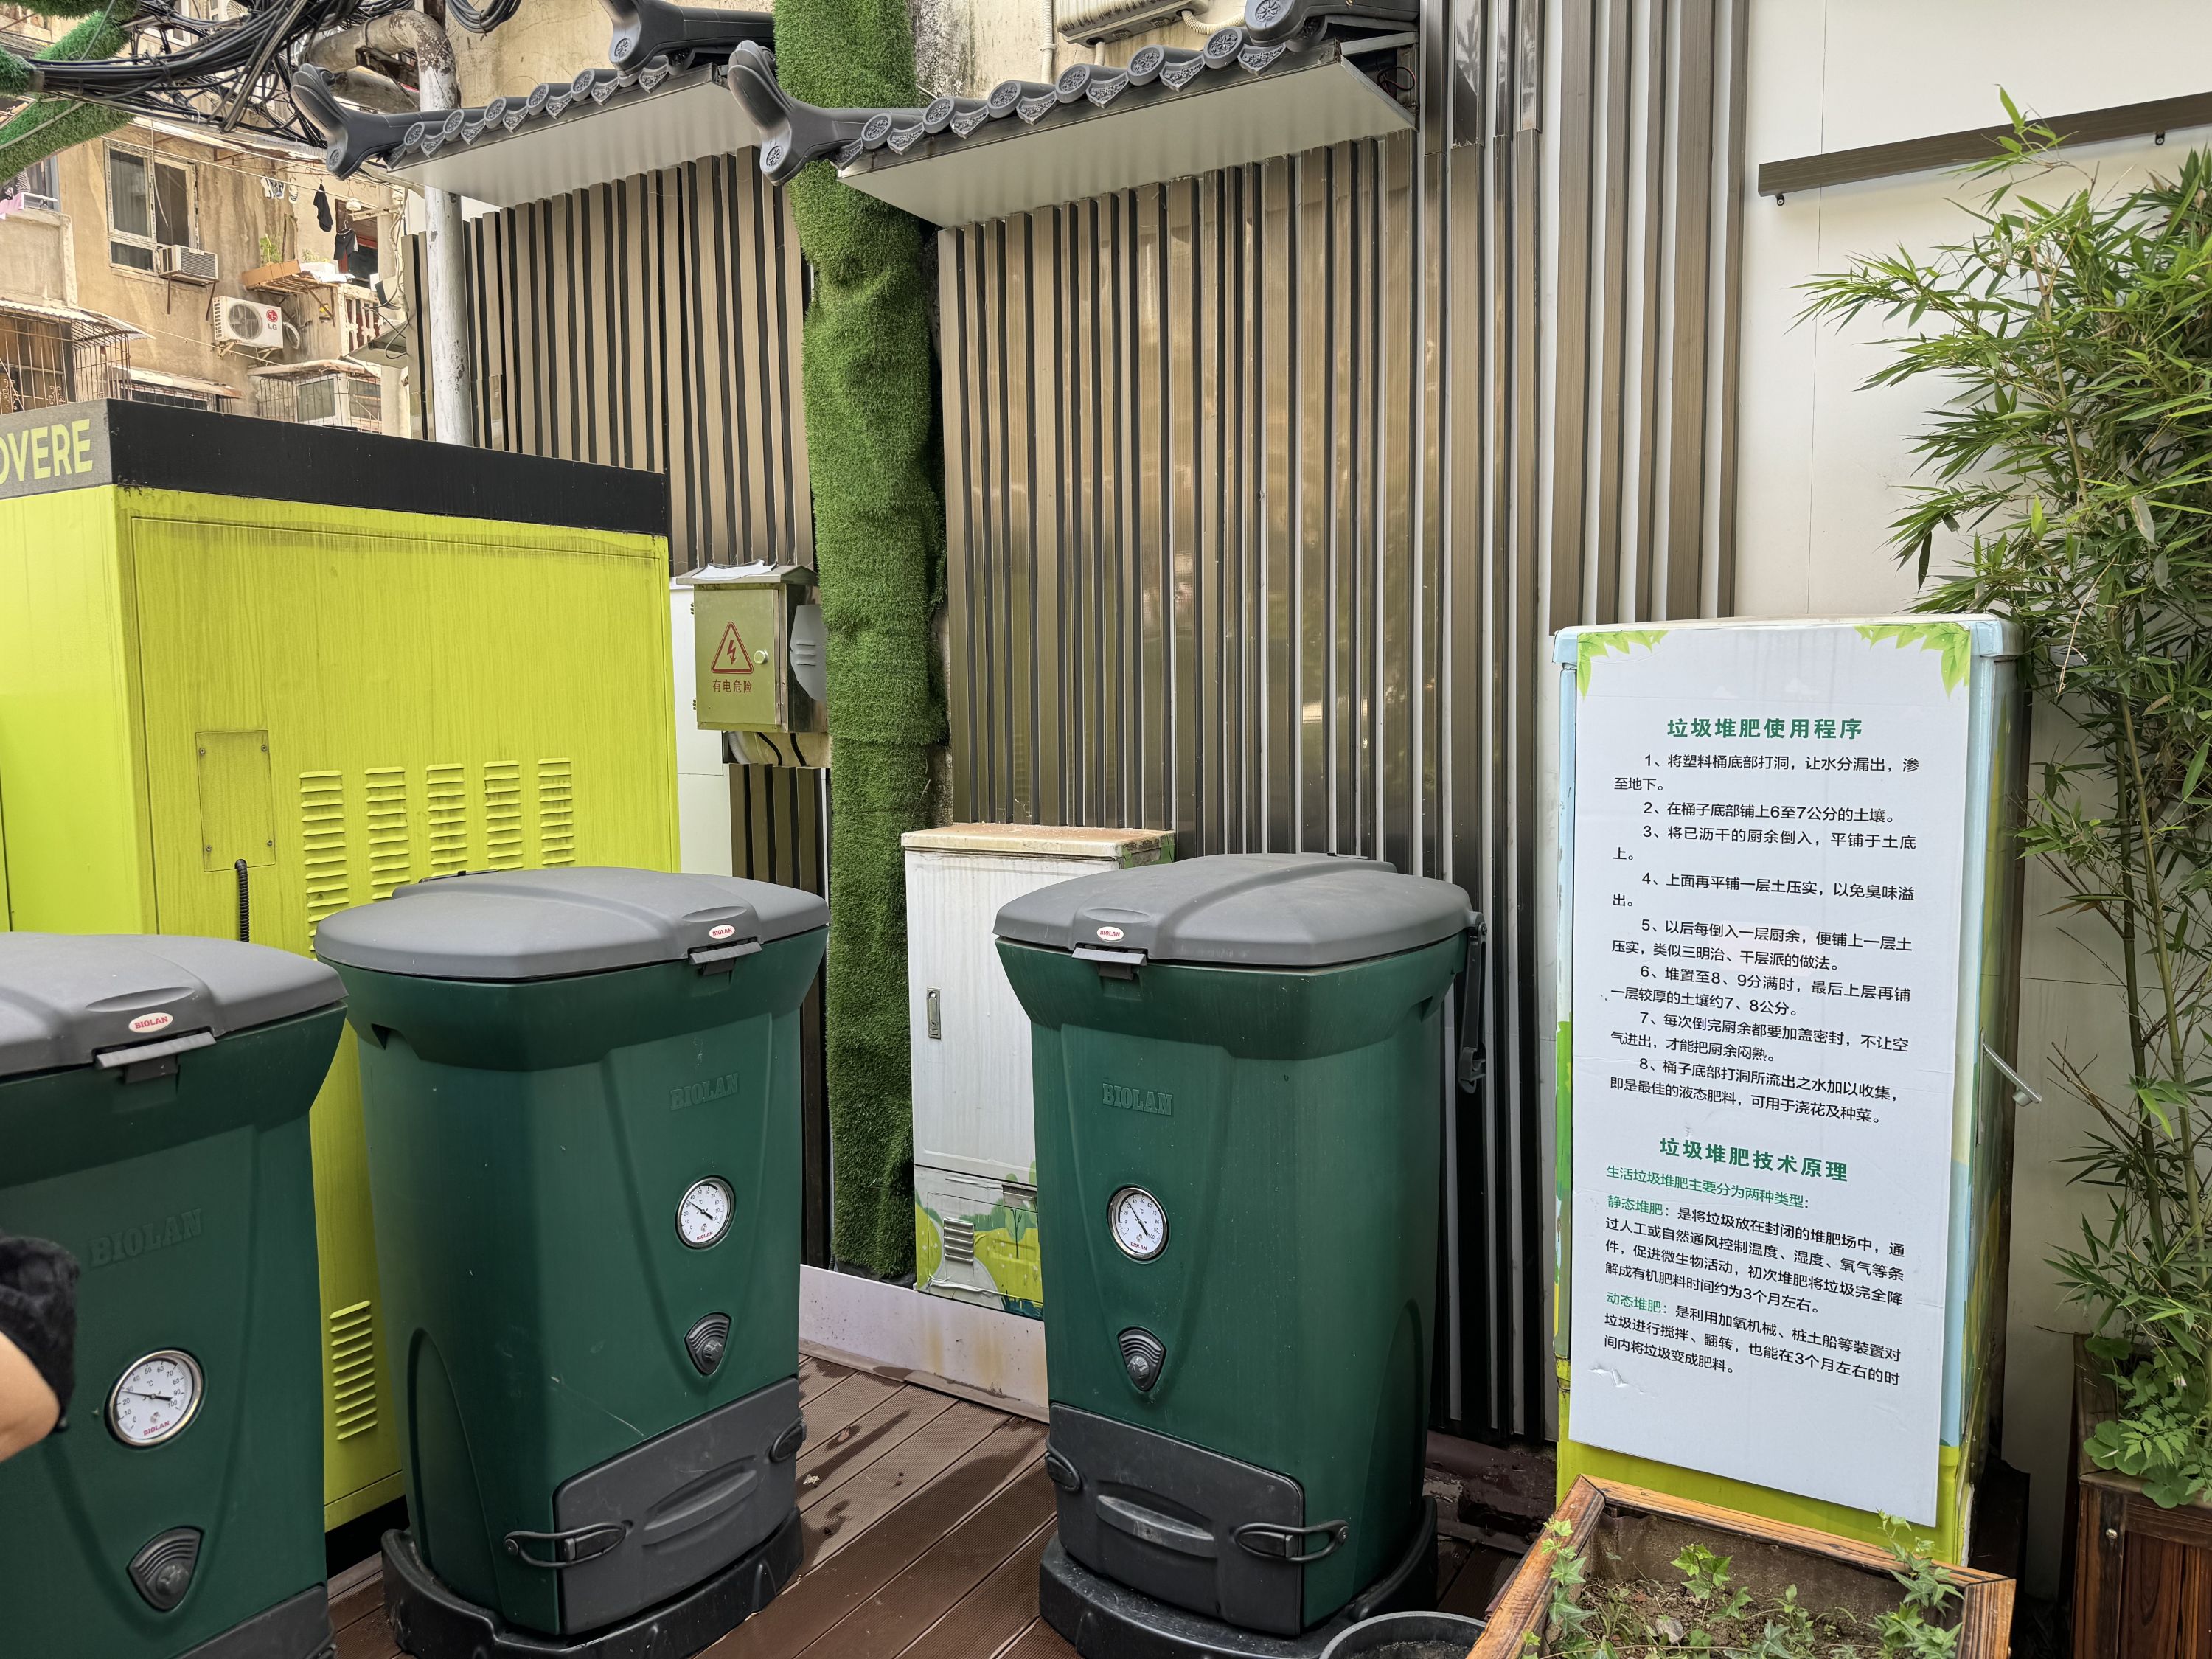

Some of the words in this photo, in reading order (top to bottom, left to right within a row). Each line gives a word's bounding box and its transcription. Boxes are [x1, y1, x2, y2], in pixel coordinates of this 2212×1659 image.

[712, 679, 752, 693] 有电危险
[1666, 717, 1863, 740] 垃圾堆肥使用程序
[1644, 754, 1919, 773] 1、将塑料桶底部打洞，让水分漏出，渗
[1614, 777, 1663, 791] 至地下。
[1643, 801, 1893, 823] 2、在桶子底部铺上6至7公分的土壤。
[1642, 825, 1917, 850] 3、将已沥干的厨余倒入，平铺于土底
[1613, 847, 1634, 860] 上。
[1613, 894, 1632, 907] 出。
[1641, 872, 1915, 901] 4、上面再平铺一层土压实，以免臭味溢
[712, 928, 732, 936] BIOLAN
[1641, 919, 1913, 951] 5、以后每倒入一层厨余，便铺上一层土
[1640, 965, 1911, 1003] 6、堆置至8、9分满时，最后上层再铺
[1610, 987, 1797, 1016] 一层较厚的土壤约7、8公分。
[134, 1016, 169, 1029] BIOLAN
[1640, 1011, 1909, 1052] 7、每次倒完厨余都要加盖密封，不让空
[1610, 1031, 1774, 1062] 气进出，才能把厨余闷熟。
[669, 1072, 738, 1111] BIOLAN
[1102, 1083, 1172, 1116] BIOLAN
[1610, 1077, 1880, 1124] 即是最佳的液态肥料，可用于浇花及种菜。
[1659, 1136, 1848, 1182] 垃圾堆肥技术原理
[1607, 1165, 1809, 1208] 生活垃圾堆肥主要分为两种类型：
[88, 1208, 201, 1270] BIOLAN
[697, 1231, 713, 1240] BIOLAN
[1605, 1217, 1904, 1281] 过人工或自然通风控制温度、湿度、氧气等条
[1605, 1239, 1903, 1306] 件，促进微生物活动，初次堆肥将垃圾完全降
[1605, 1261, 1819, 1313] 解成有机肥料时间约为3个月左右。
[1604, 1312, 1900, 1386] 垃圾进行搅拌、翻转，也能在3个月左右的时
[1604, 1335, 1733, 1374] 间内将垃圾变成肥料。
[122, 1397, 130, 1405] 20
[168, 1399, 178, 1408] 100
[143, 1420, 170, 1436] BIOLAN
